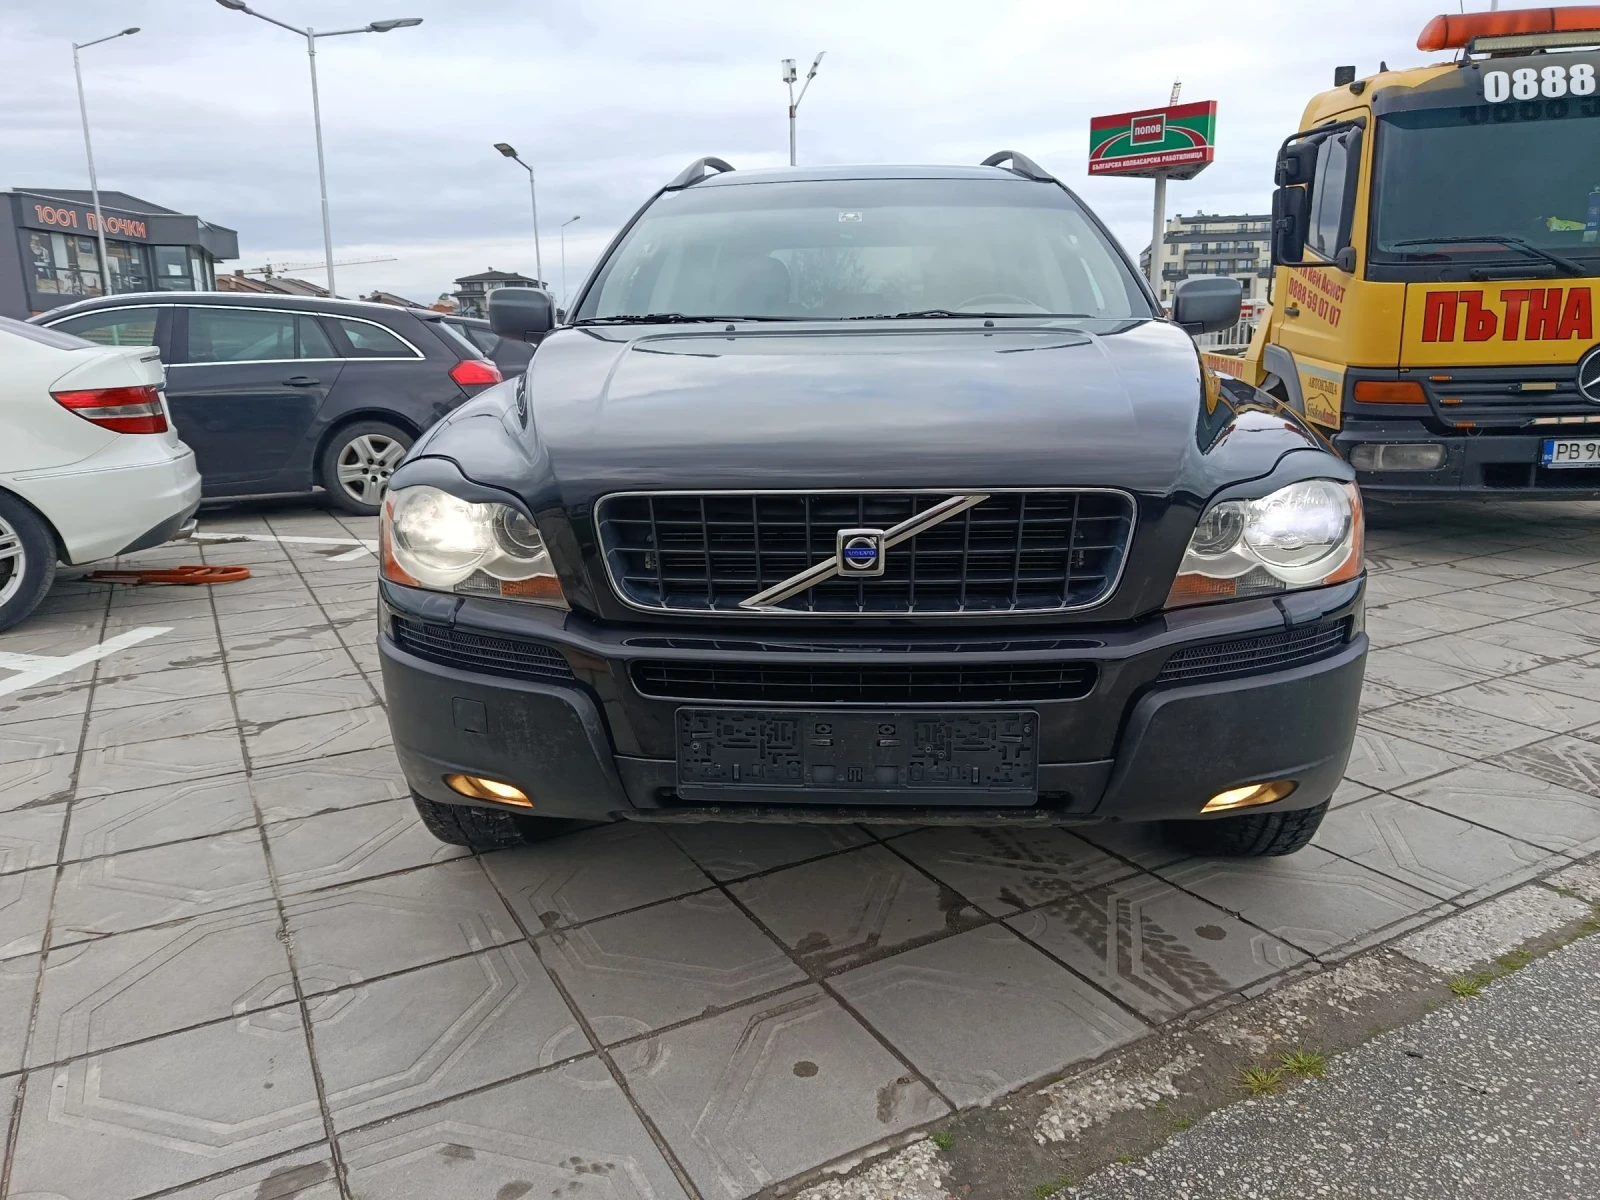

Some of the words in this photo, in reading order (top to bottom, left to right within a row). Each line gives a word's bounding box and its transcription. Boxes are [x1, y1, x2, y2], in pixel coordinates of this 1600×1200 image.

[1483, 63, 1596, 103] 0888
[1134, 124, 1162, 136] ПОПОВ
[35, 205, 78, 228] 1001
[1288, 277, 1307, 305] 0888
[1306, 290, 1318, 313] 59
[1318, 297, 1329, 320] 07
[1329, 305, 1342, 328] 07
[1422, 287, 1593, 343] ПЪТНА
[1556, 443, 1581, 460] PB
